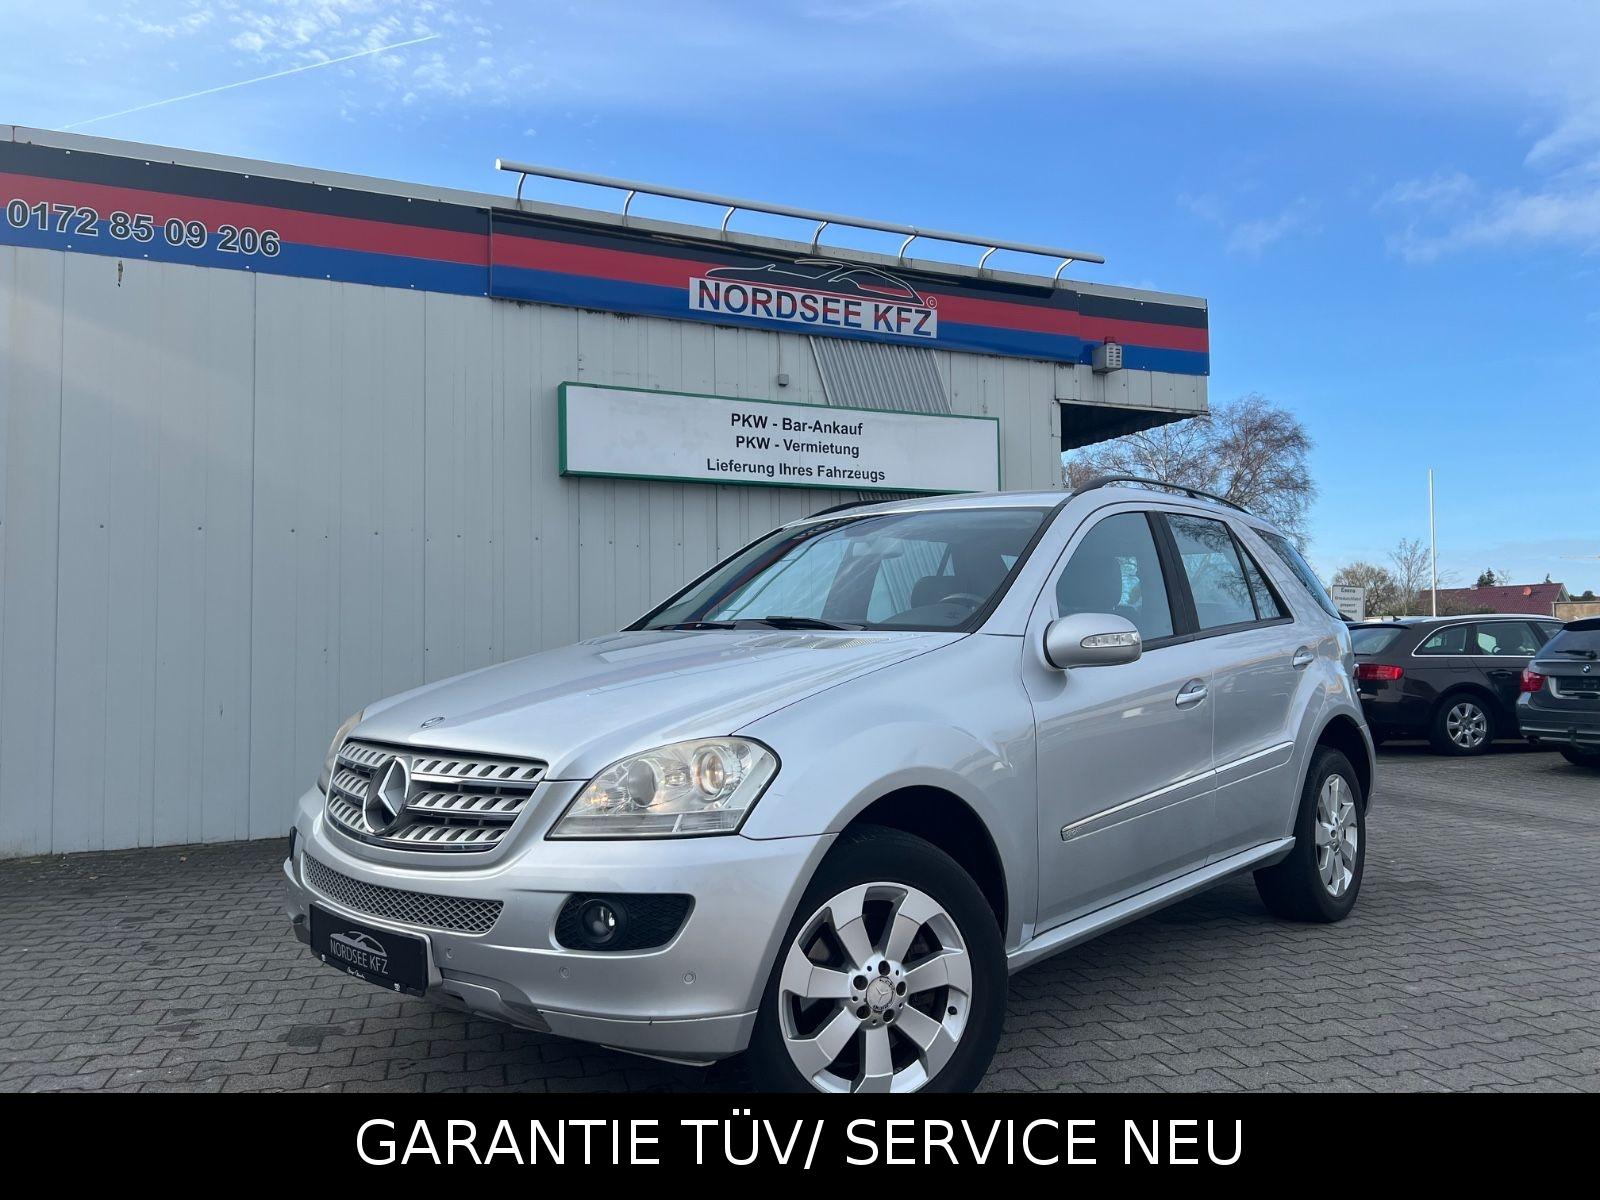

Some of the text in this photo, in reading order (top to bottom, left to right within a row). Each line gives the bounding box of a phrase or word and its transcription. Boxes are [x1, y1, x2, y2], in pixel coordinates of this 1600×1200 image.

[7, 199, 280, 257] 0172 85 09 206
[699, 280, 862, 328] NORDSEE
[874, 303, 932, 337] KFZ
[731, 413, 768, 429] PKW
[782, 417, 863, 435] Bar-Ankauf
[736, 435, 771, 450] PKW
[783, 438, 860, 459] Vermietung
[707, 458, 886, 483] Lieferung Ihres Fahrzeugs
[329, 939, 368, 968] NORDSEE
[369, 956, 389, 975] KFZ
